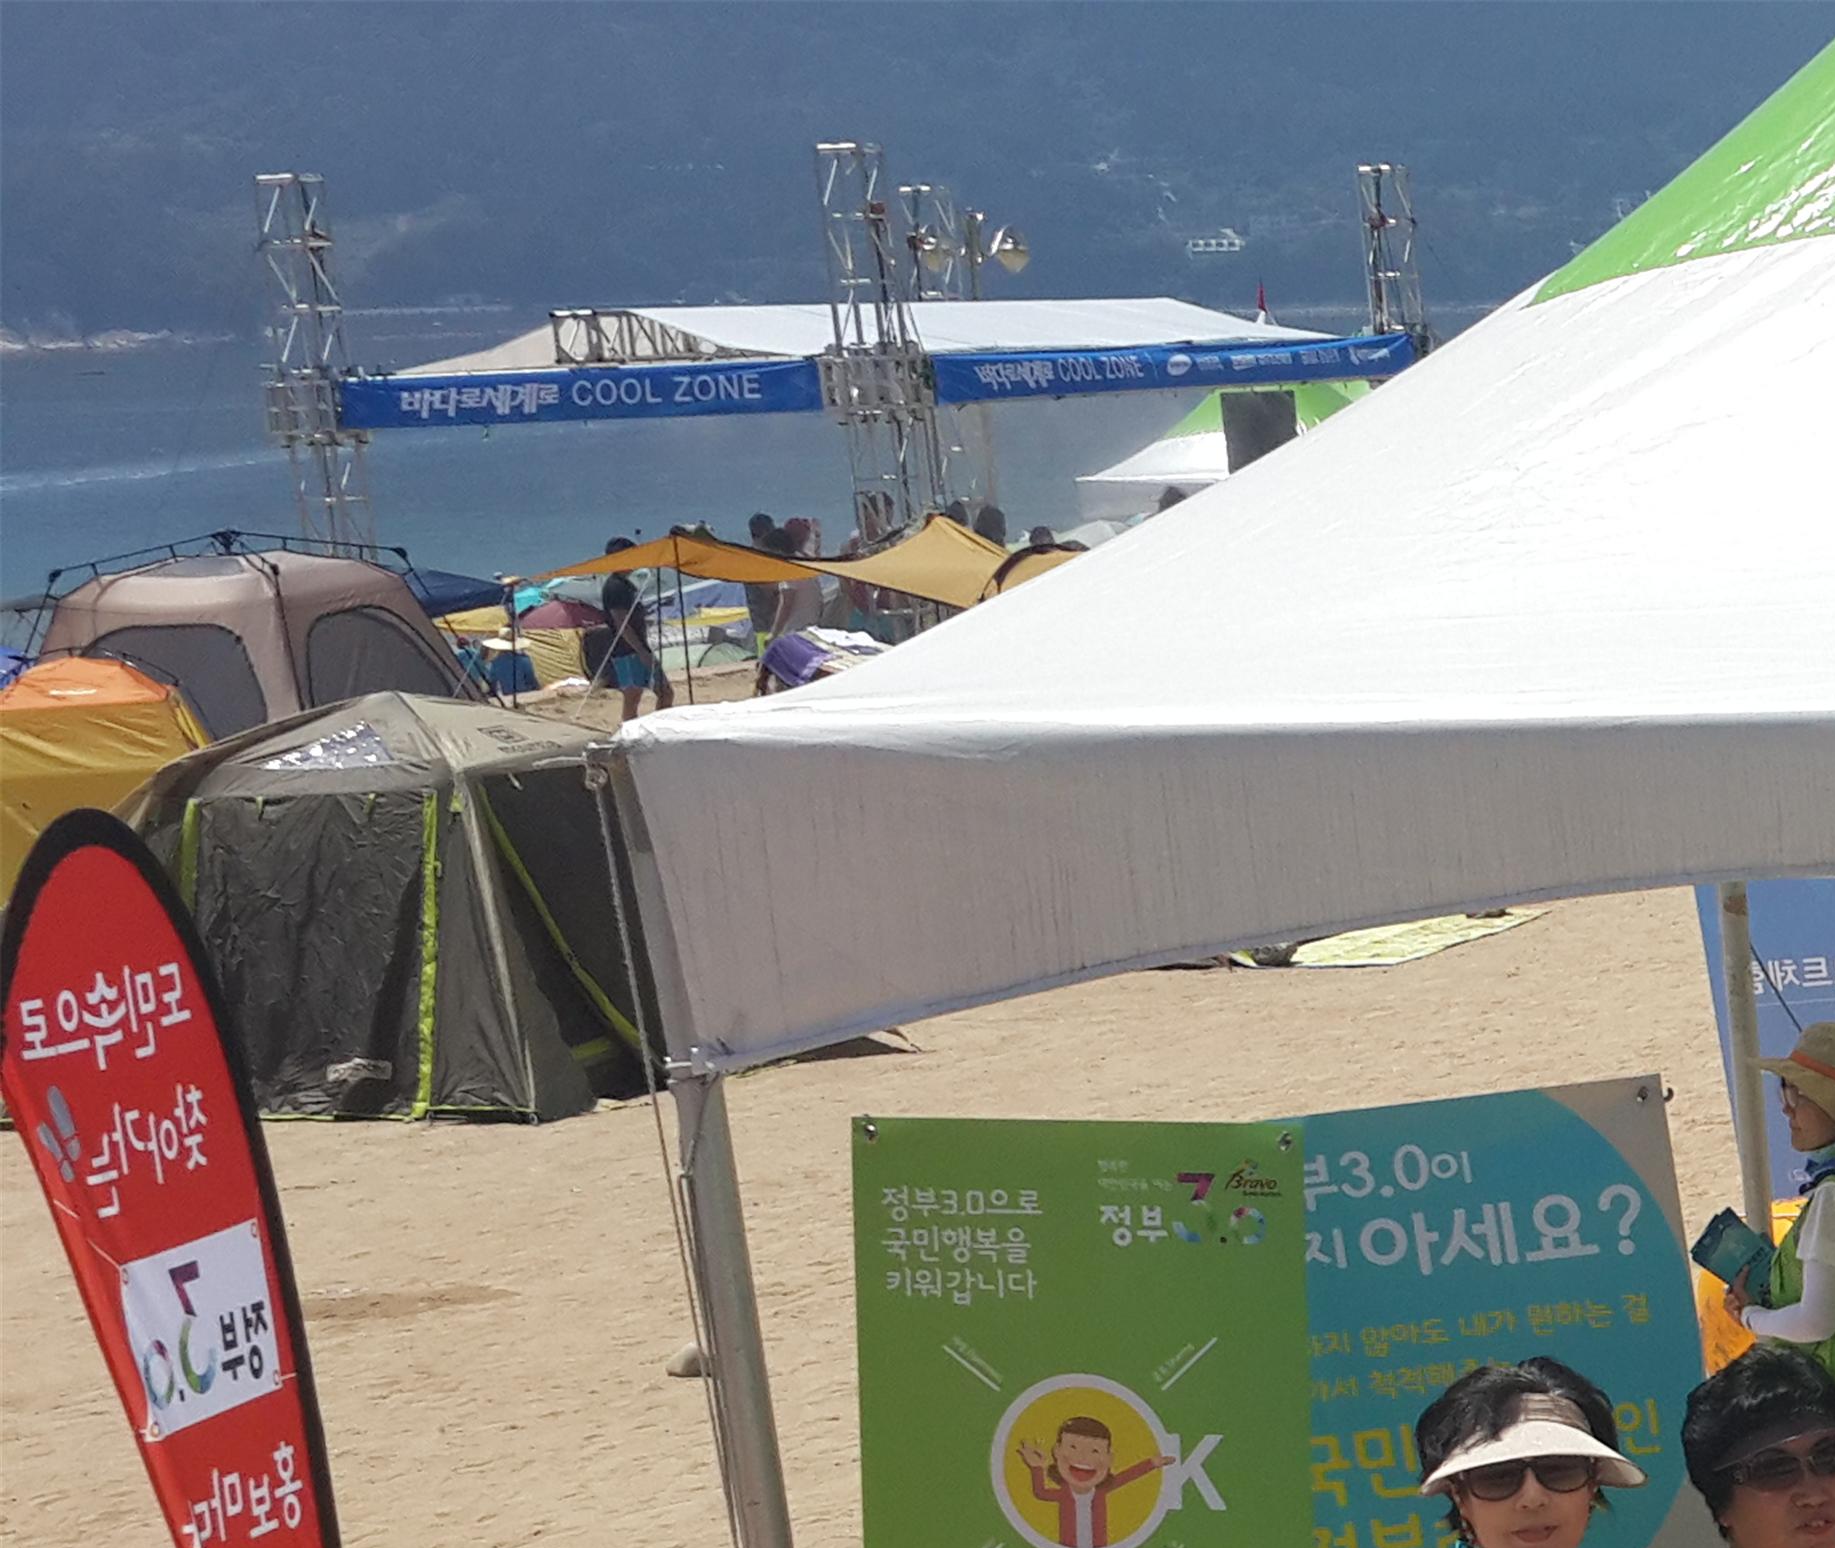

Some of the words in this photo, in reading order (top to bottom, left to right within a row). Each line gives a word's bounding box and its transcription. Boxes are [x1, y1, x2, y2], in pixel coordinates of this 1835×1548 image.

[1058, 357, 1098, 384] COOL
[1105, 354, 1144, 379] ZONE
[401, 383, 559, 419] 바다로세계로
[571, 380, 662, 407] COOL
[673, 374, 761, 402] ZONE
[881, 1186, 1043, 1222] 정부3.0으로
[881, 1227, 1032, 1264] 국민행복을
[1361, 1183, 1642, 1276] 아세요?
[885, 1267, 1038, 1306] 키워갑니다
